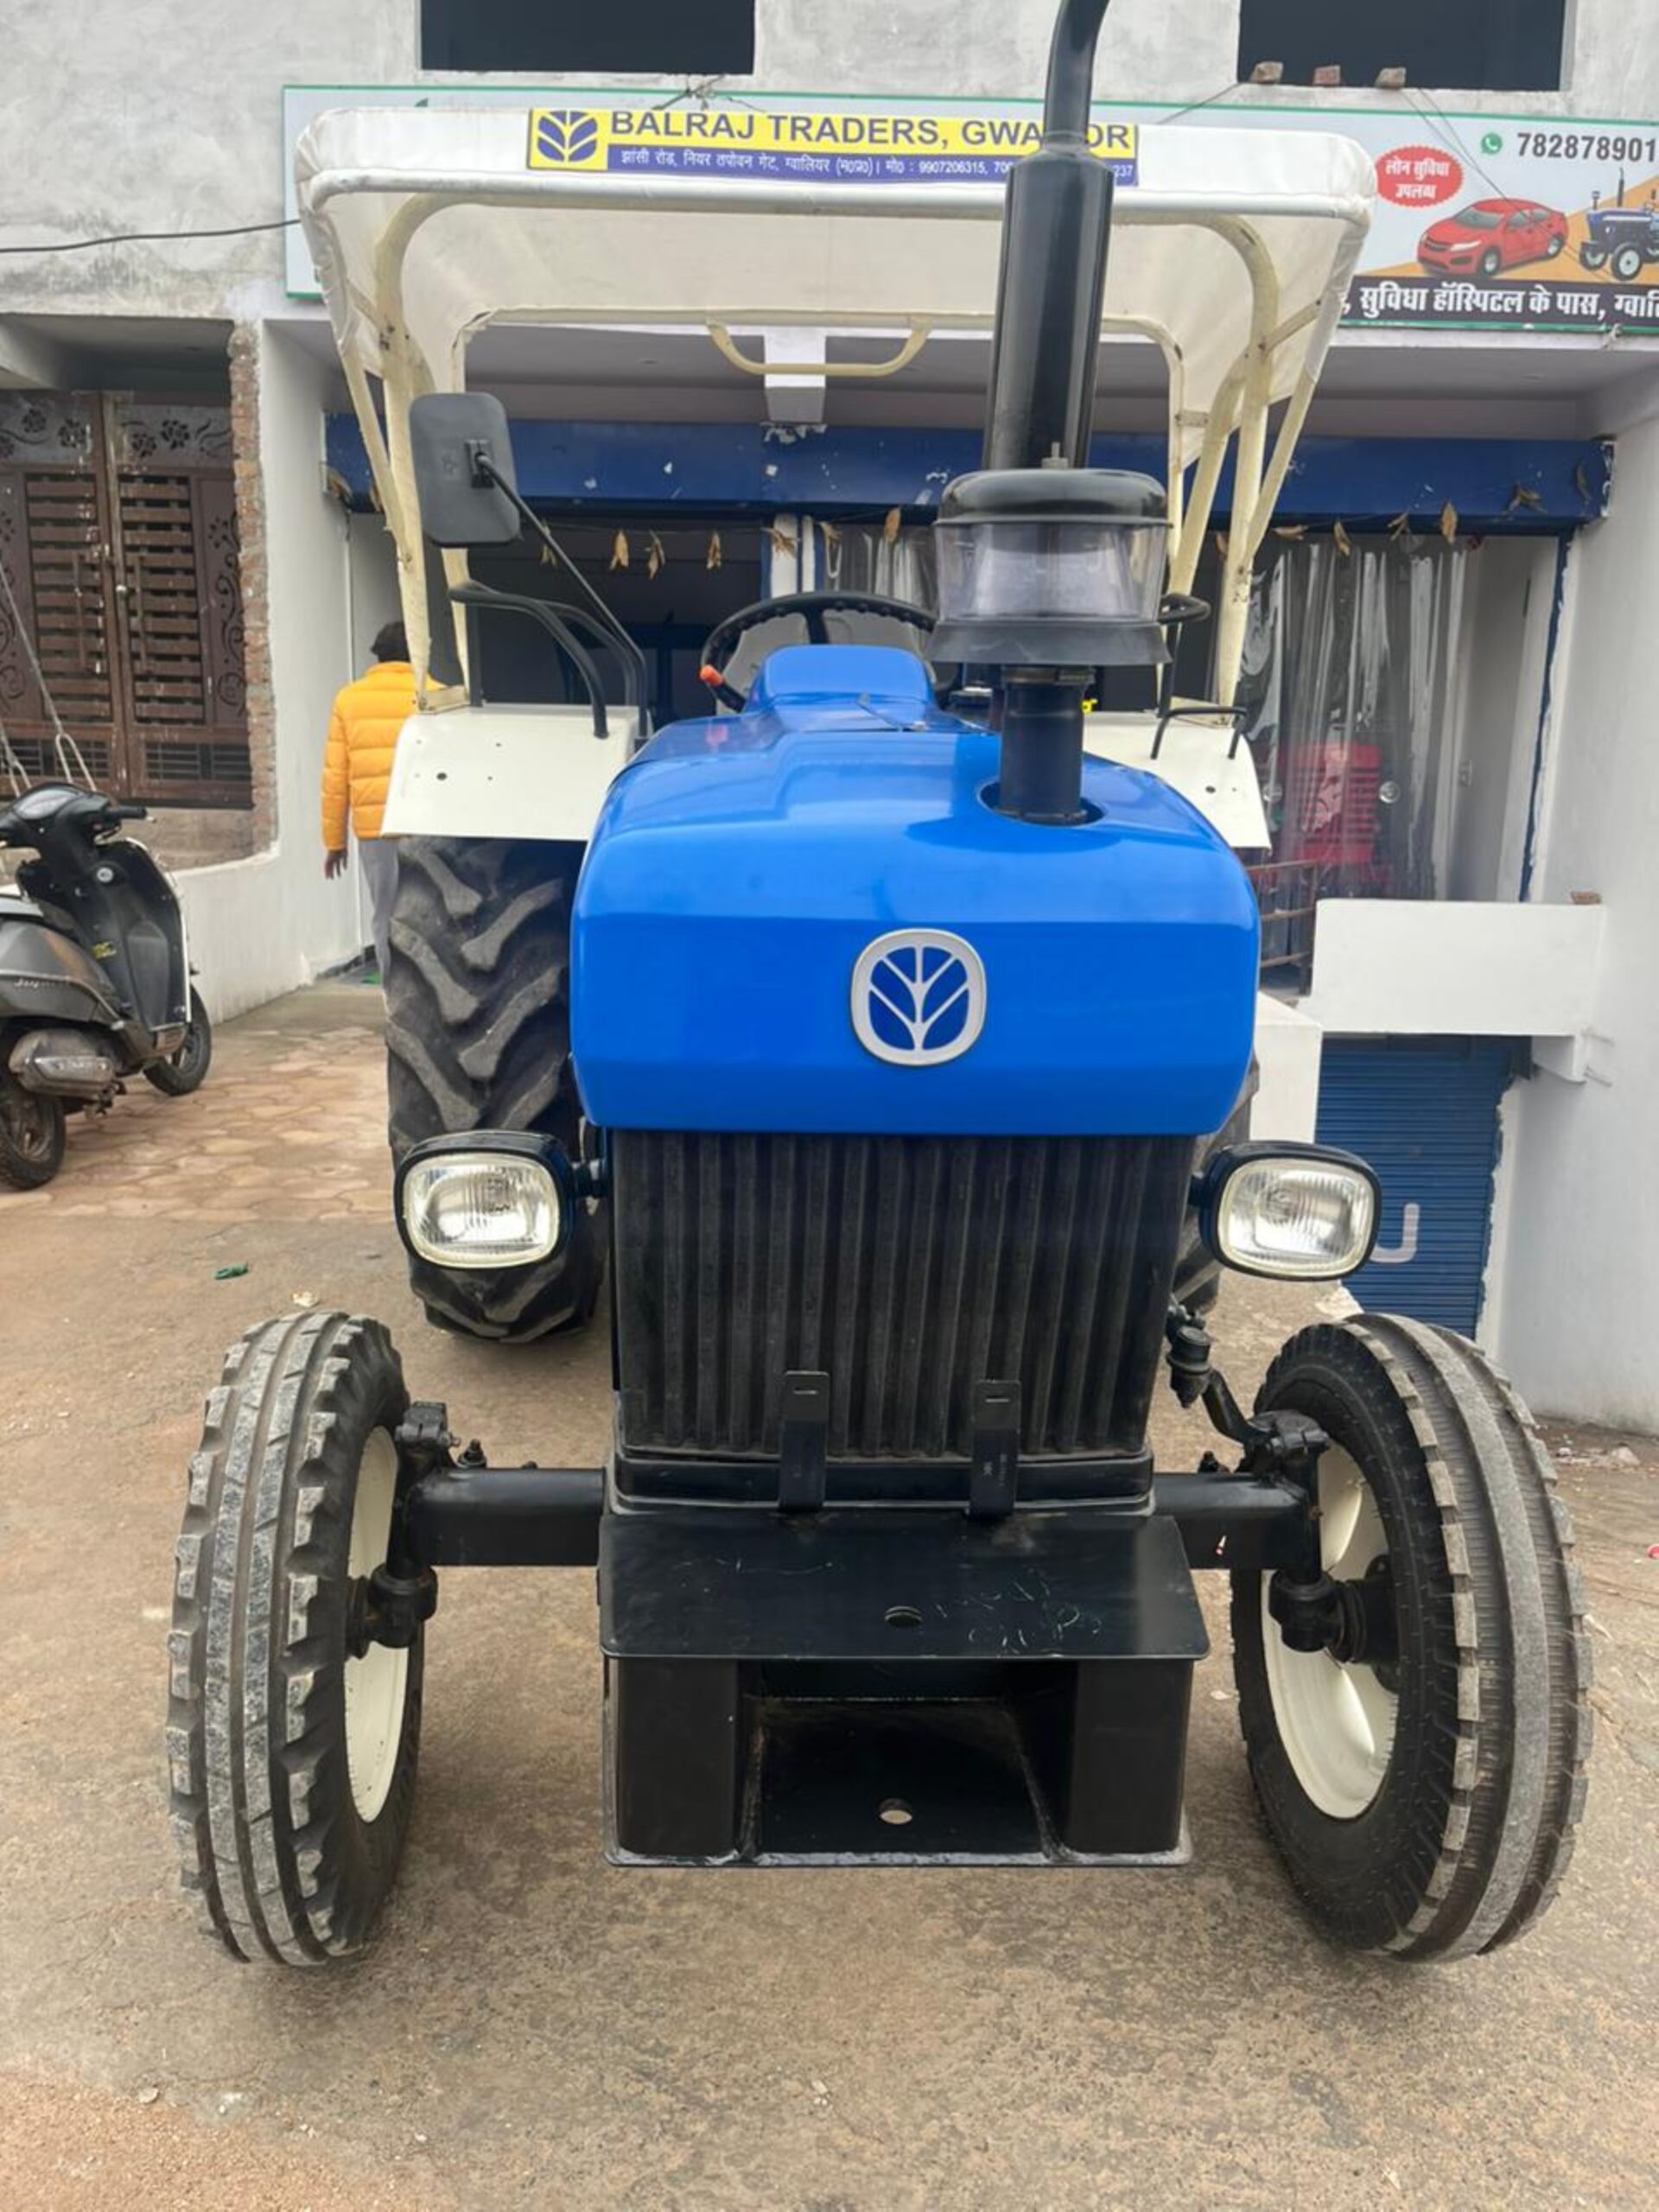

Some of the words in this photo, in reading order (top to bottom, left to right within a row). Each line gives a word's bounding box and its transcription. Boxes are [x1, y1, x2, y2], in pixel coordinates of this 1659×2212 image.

[611, 111, 753, 139] BALRAJ
[768, 114, 948, 149] TRADERS,
[961, 119, 1130, 149] GWAOR
[1385, 156, 1411, 175] लोन
[1414, 157, 1451, 181] सुविधा
[1359, 281, 1428, 319] सुविधा
[1433, 282, 1525, 315] हॉस्पिटल
[1529, 283, 1551, 315] के
